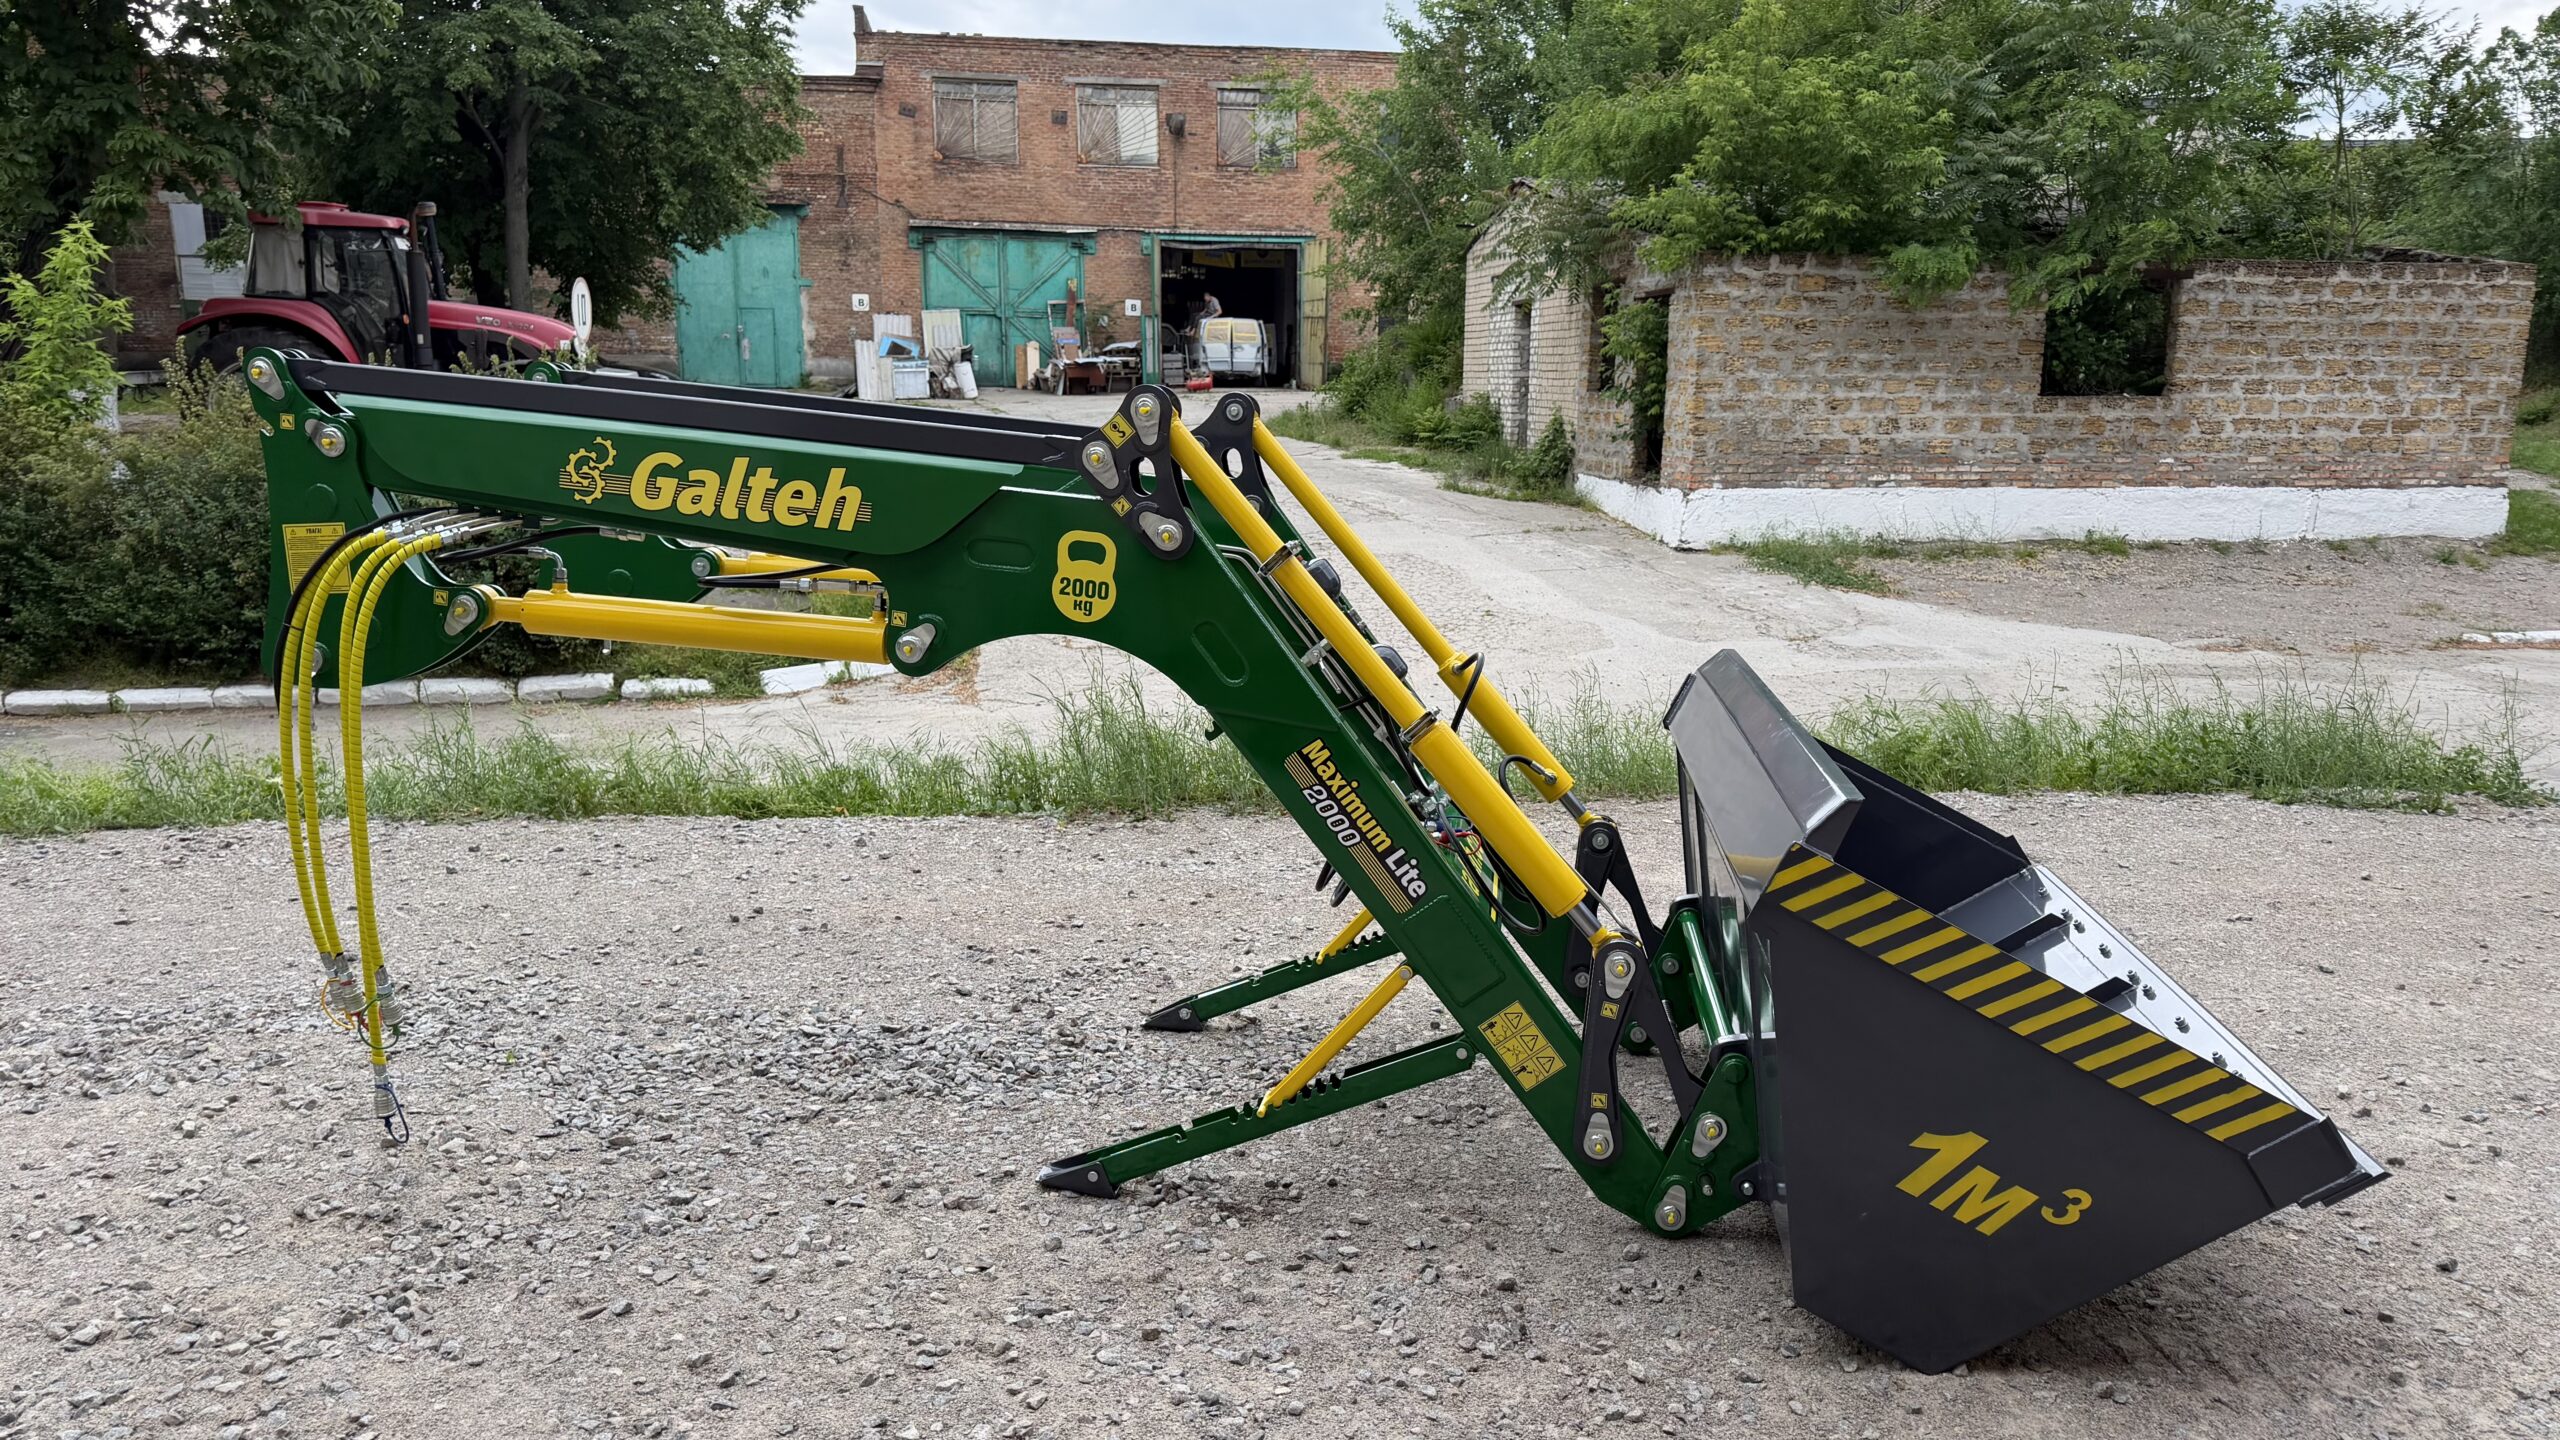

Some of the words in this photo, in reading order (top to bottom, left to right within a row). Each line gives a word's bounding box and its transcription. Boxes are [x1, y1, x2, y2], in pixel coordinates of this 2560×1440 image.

[577, 293, 587, 326] 10
[629, 451, 863, 532] Galteh
[1058, 576, 1110, 601] 2000
[1301, 738, 1392, 853] Maximum
[1384, 848, 1427, 899] Lite
[1302, 785, 1361, 847] 2000
